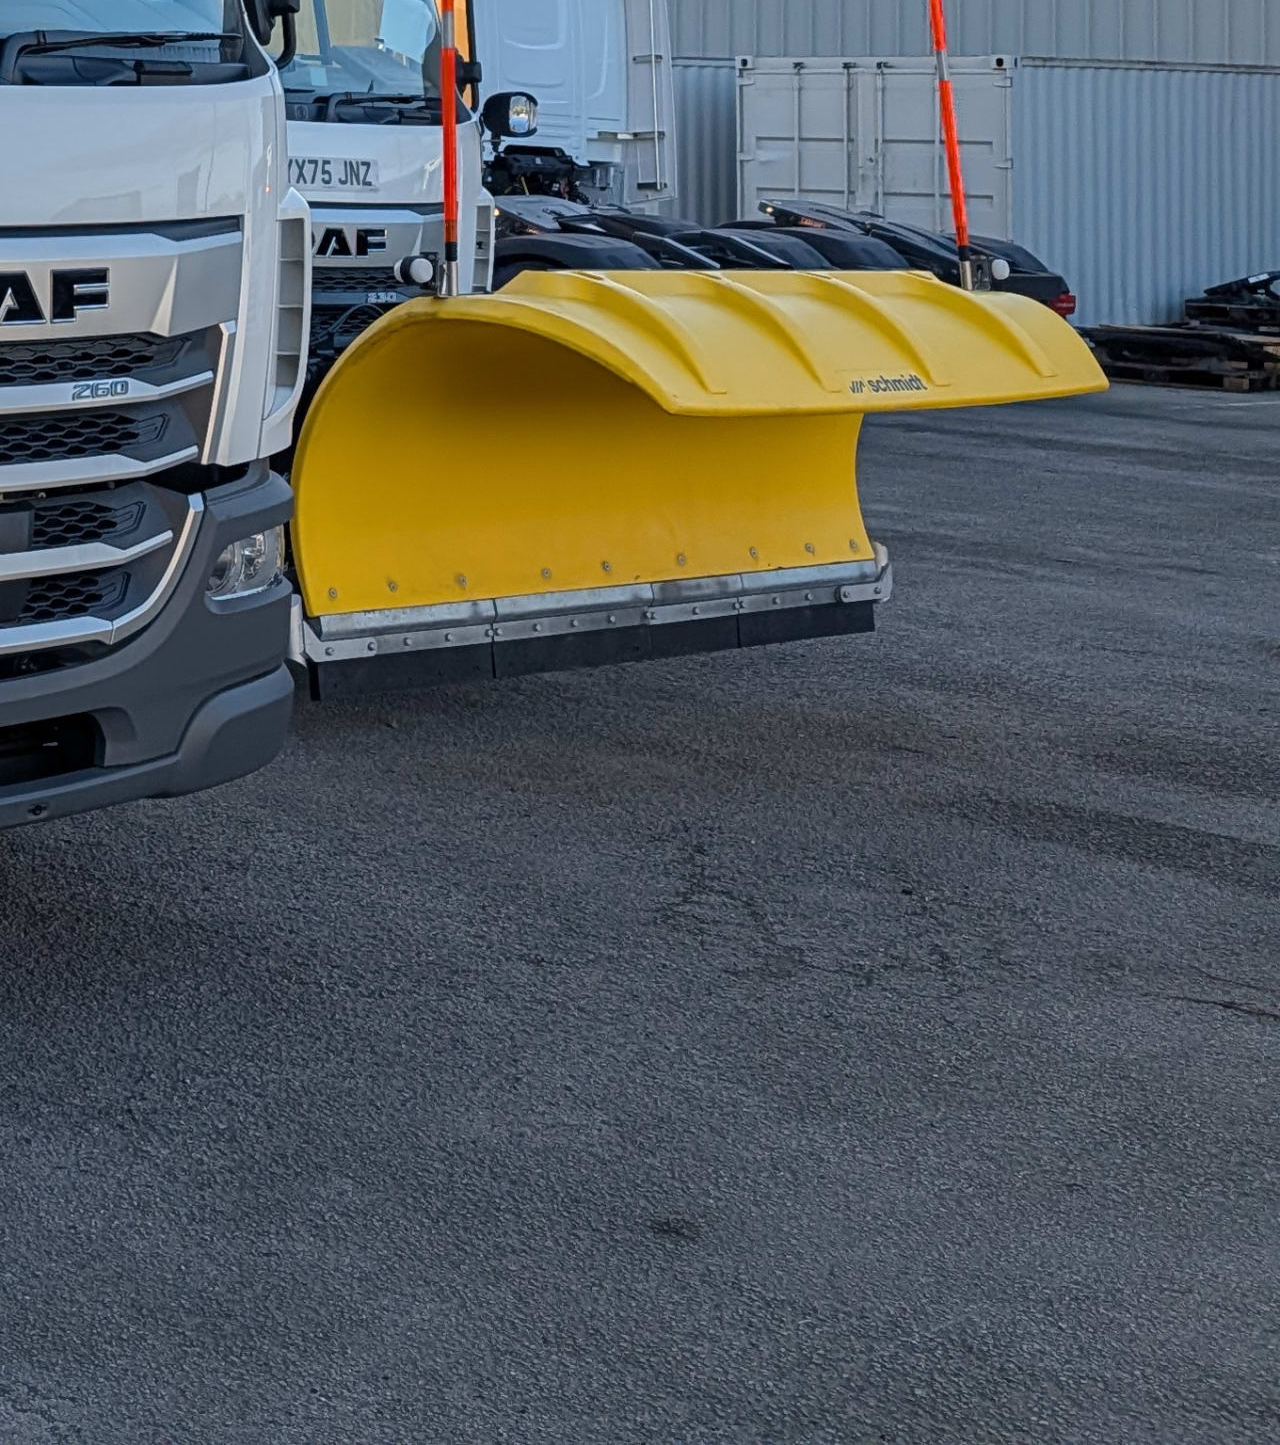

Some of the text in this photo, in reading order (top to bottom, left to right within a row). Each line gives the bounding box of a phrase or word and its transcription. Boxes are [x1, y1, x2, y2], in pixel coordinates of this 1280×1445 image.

[338, 160, 373, 187] JNZ
[311, 227, 388, 259] AF
[71, 380, 130, 402] 260
[868, 374, 927, 394] schmidt
